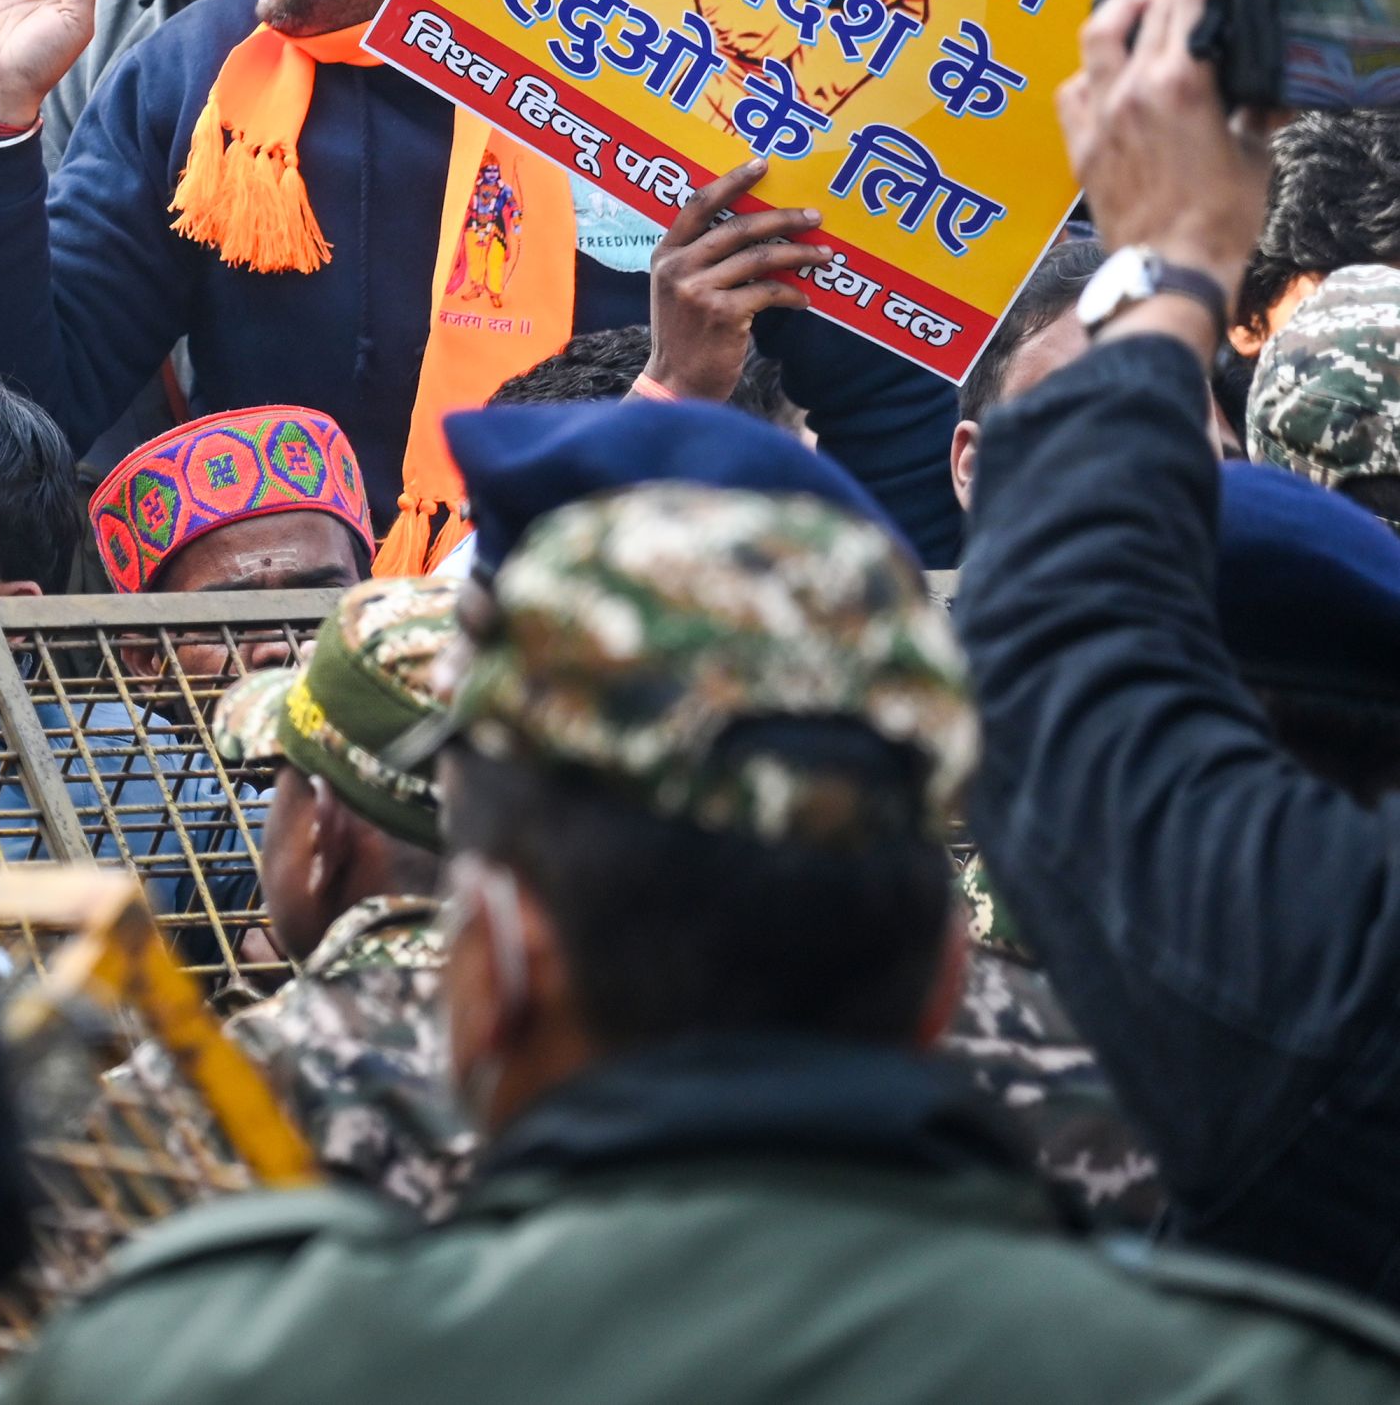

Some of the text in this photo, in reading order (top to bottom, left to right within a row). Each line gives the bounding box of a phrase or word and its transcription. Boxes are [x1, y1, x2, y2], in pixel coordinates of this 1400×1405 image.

[927, 21, 1028, 119] के
[402, 10, 505, 97] विश्व
[507, 75, 611, 178] हिन्दू
[881, 290, 963, 348] दल
[732, 58, 832, 159] के
[828, 122, 1006, 256] लिए
[489, 317, 512, 332] दल
